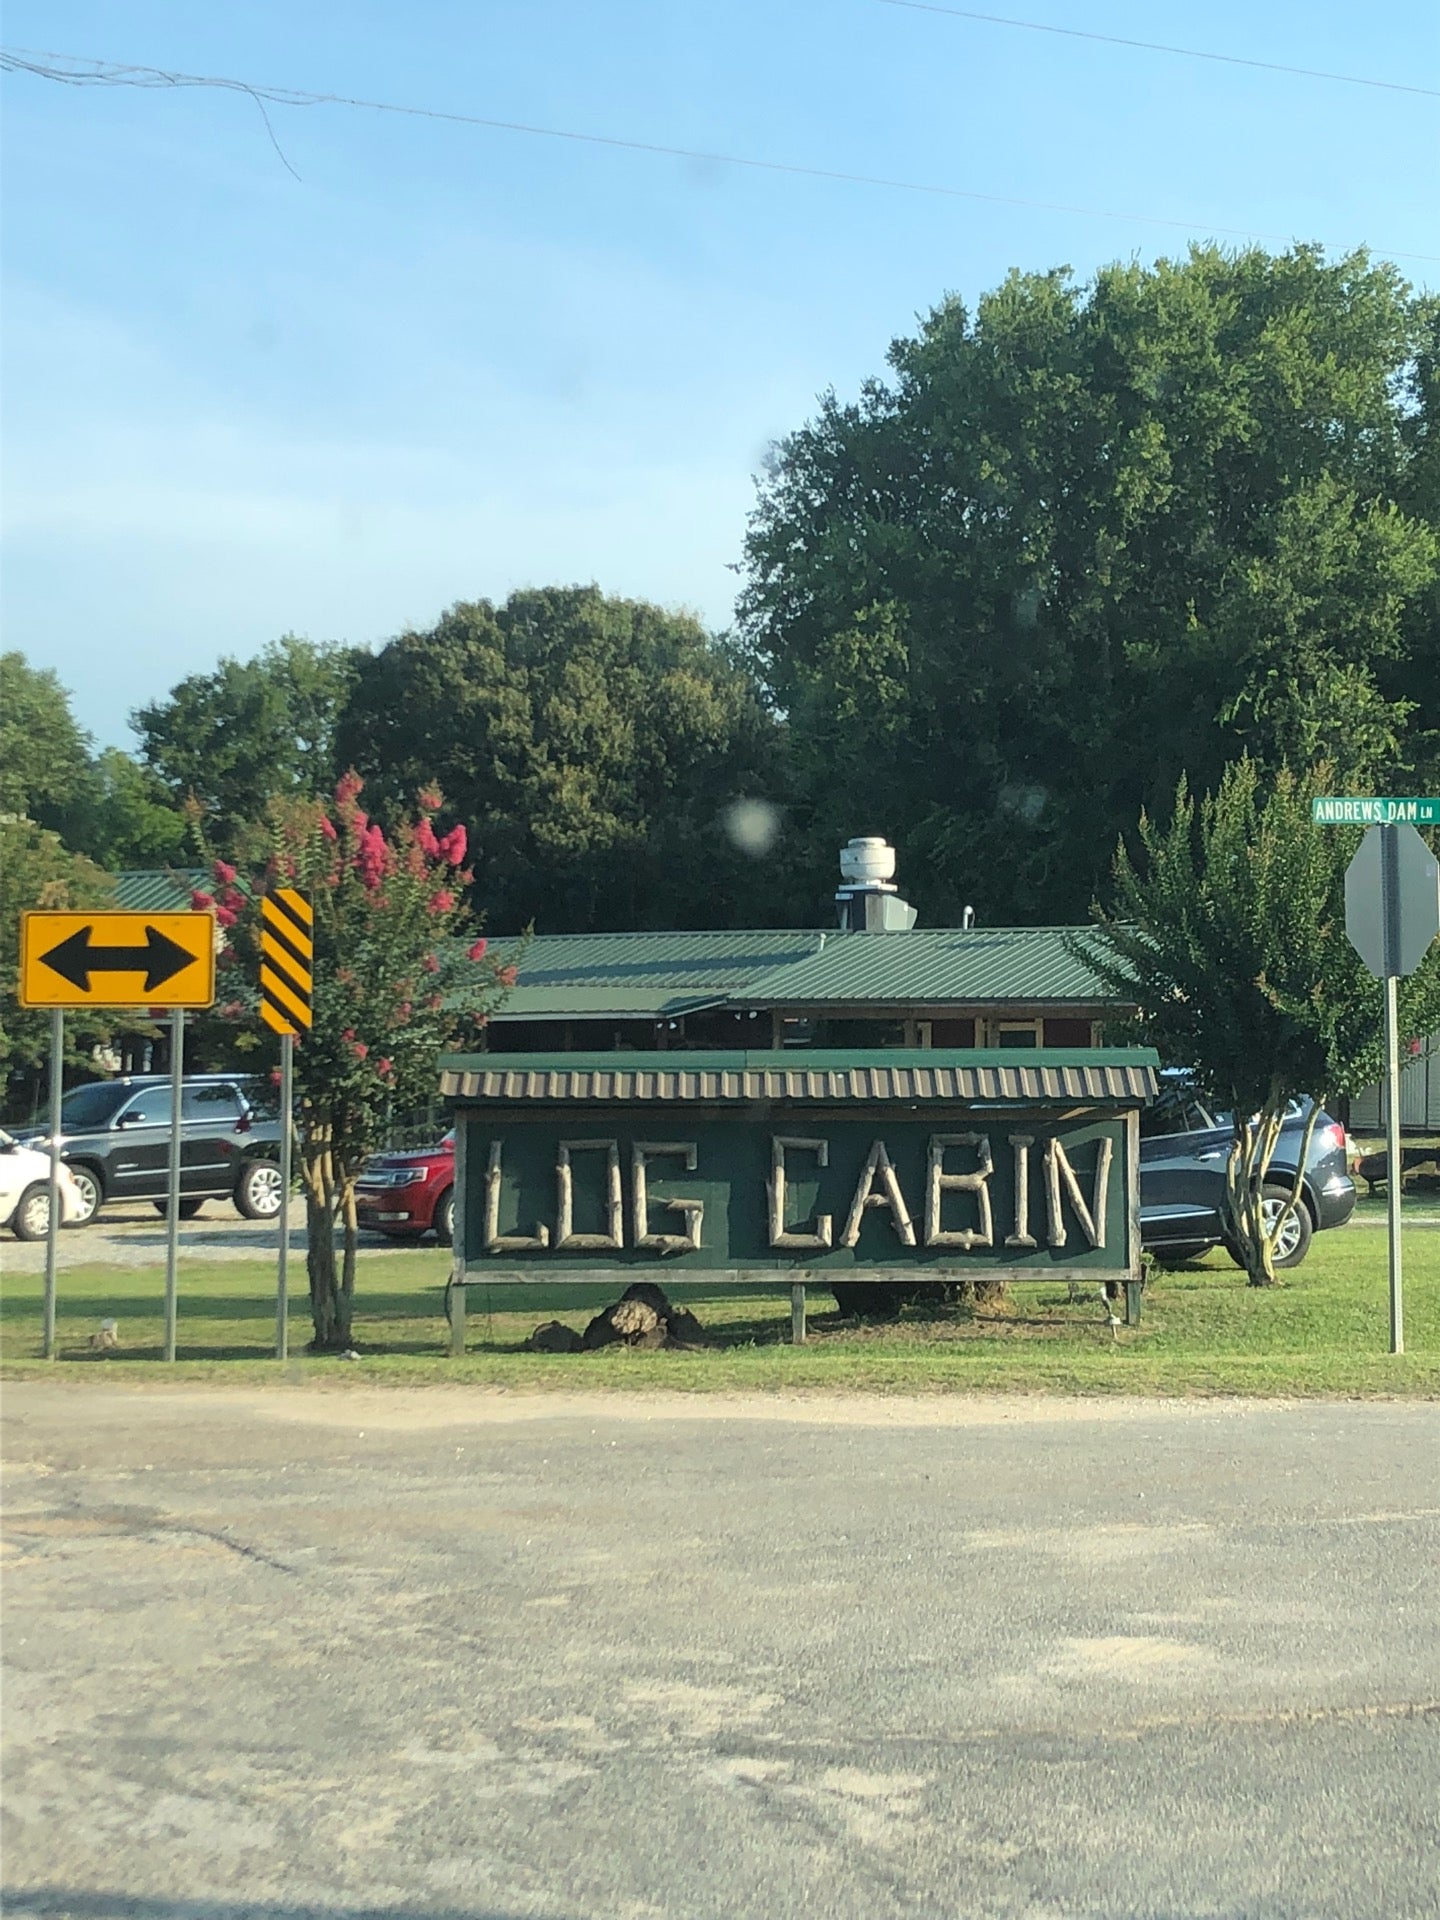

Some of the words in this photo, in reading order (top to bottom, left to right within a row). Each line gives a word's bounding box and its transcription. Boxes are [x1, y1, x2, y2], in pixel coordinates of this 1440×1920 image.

[1316, 801, 1382, 821] ANDREWS
[1387, 801, 1417, 821] DAM
[1420, 806, 1433, 819] LN
[485, 1138, 704, 1252] LOG
[766, 1132, 1113, 1249] CABIN
